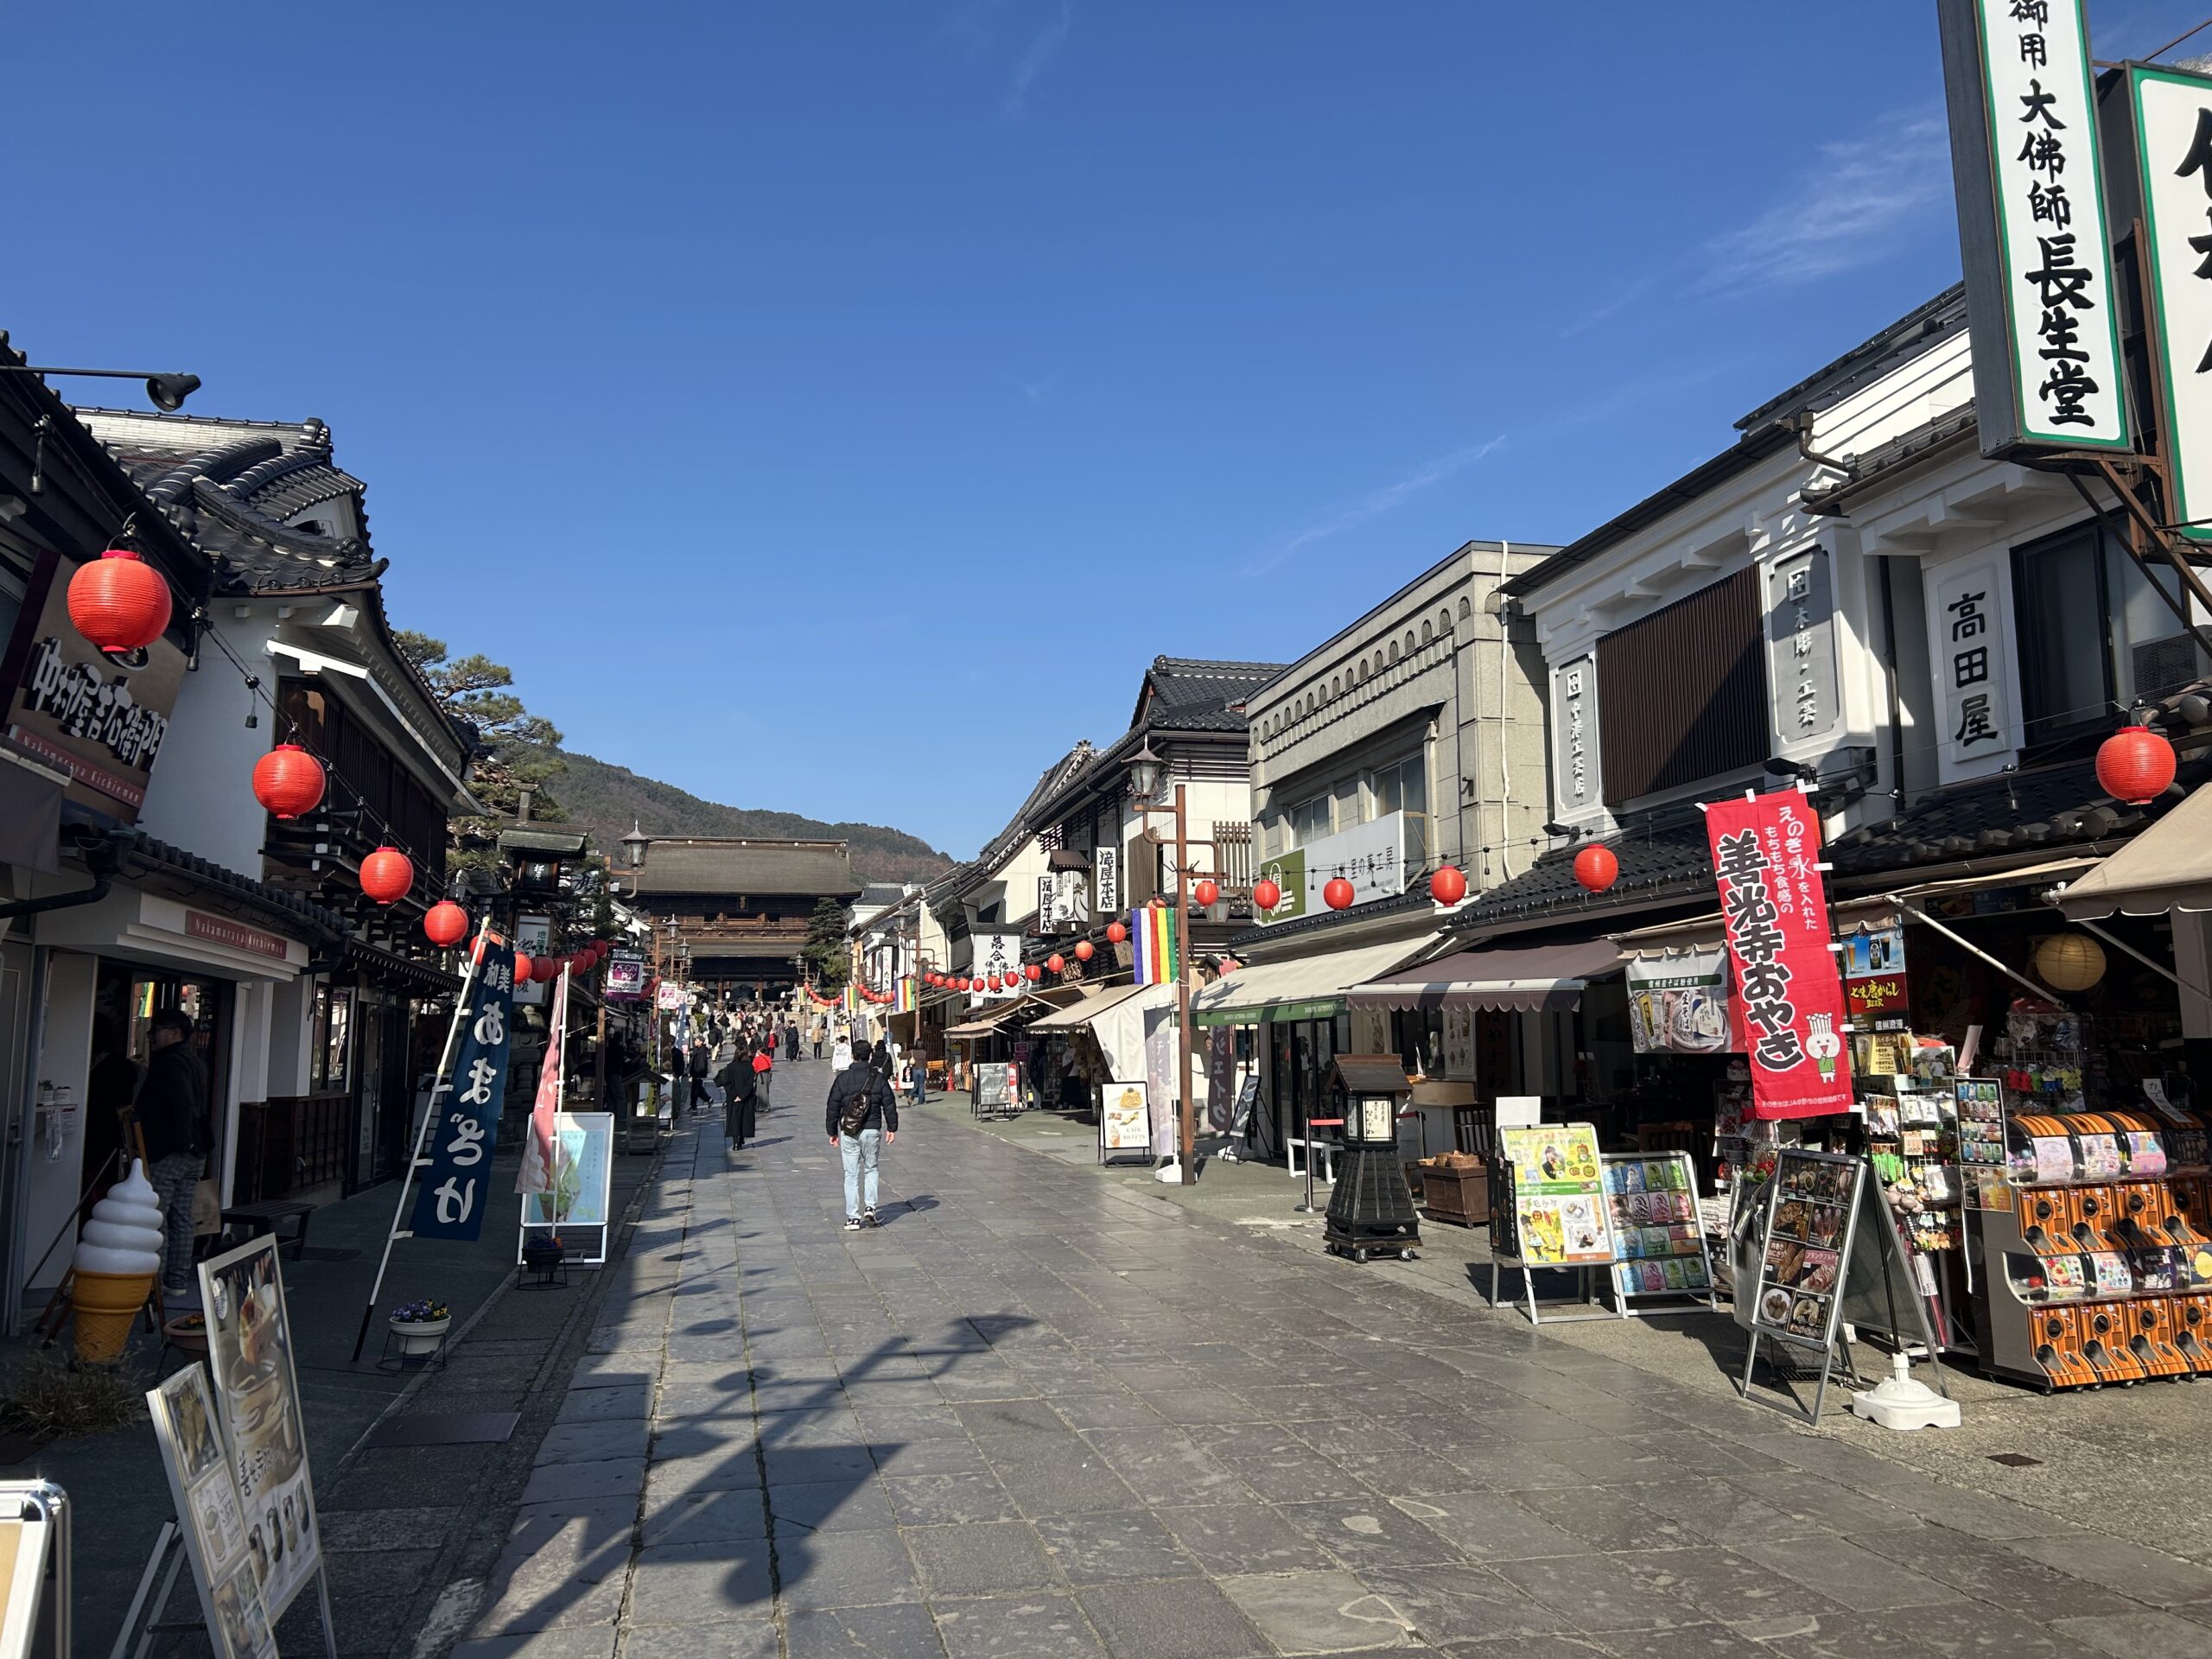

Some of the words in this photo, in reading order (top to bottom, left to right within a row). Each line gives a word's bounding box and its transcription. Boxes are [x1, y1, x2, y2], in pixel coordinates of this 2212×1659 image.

[2017, 79, 2071, 231] 大佛師
[2024, 233, 2100, 428] 長生堂
[1794, 606, 1818, 724] 木彫・工芸
[1948, 591, 1999, 748] 高田屋
[90, 770, 141, 803] Kichiemon
[1764, 825, 1794, 914] もちもち食感の
[194, 918, 245, 945] Nakamuraya
[248, 932, 284, 954] Kichiemon
[989, 934, 1006, 962] 落合
[1716, 827, 1806, 1073] 善光寺おやき
[1648, 976, 1700, 988] 信州産そば粉使用
[1850, 979, 1901, 1000] 七味唐からし
[1681, 993, 1691, 1030] 生そば
[1865, 998, 1885, 1008] BEER
[1875, 1018, 1904, 1031] 信州浪漫
[1876, 1035, 1897, 1044] ハイボール
[1767, 1249, 1785, 1259] おにぎり
[1770, 1242, 1784, 1251] 肉巻き
[1805, 1251, 1835, 1260] フランクフルト
